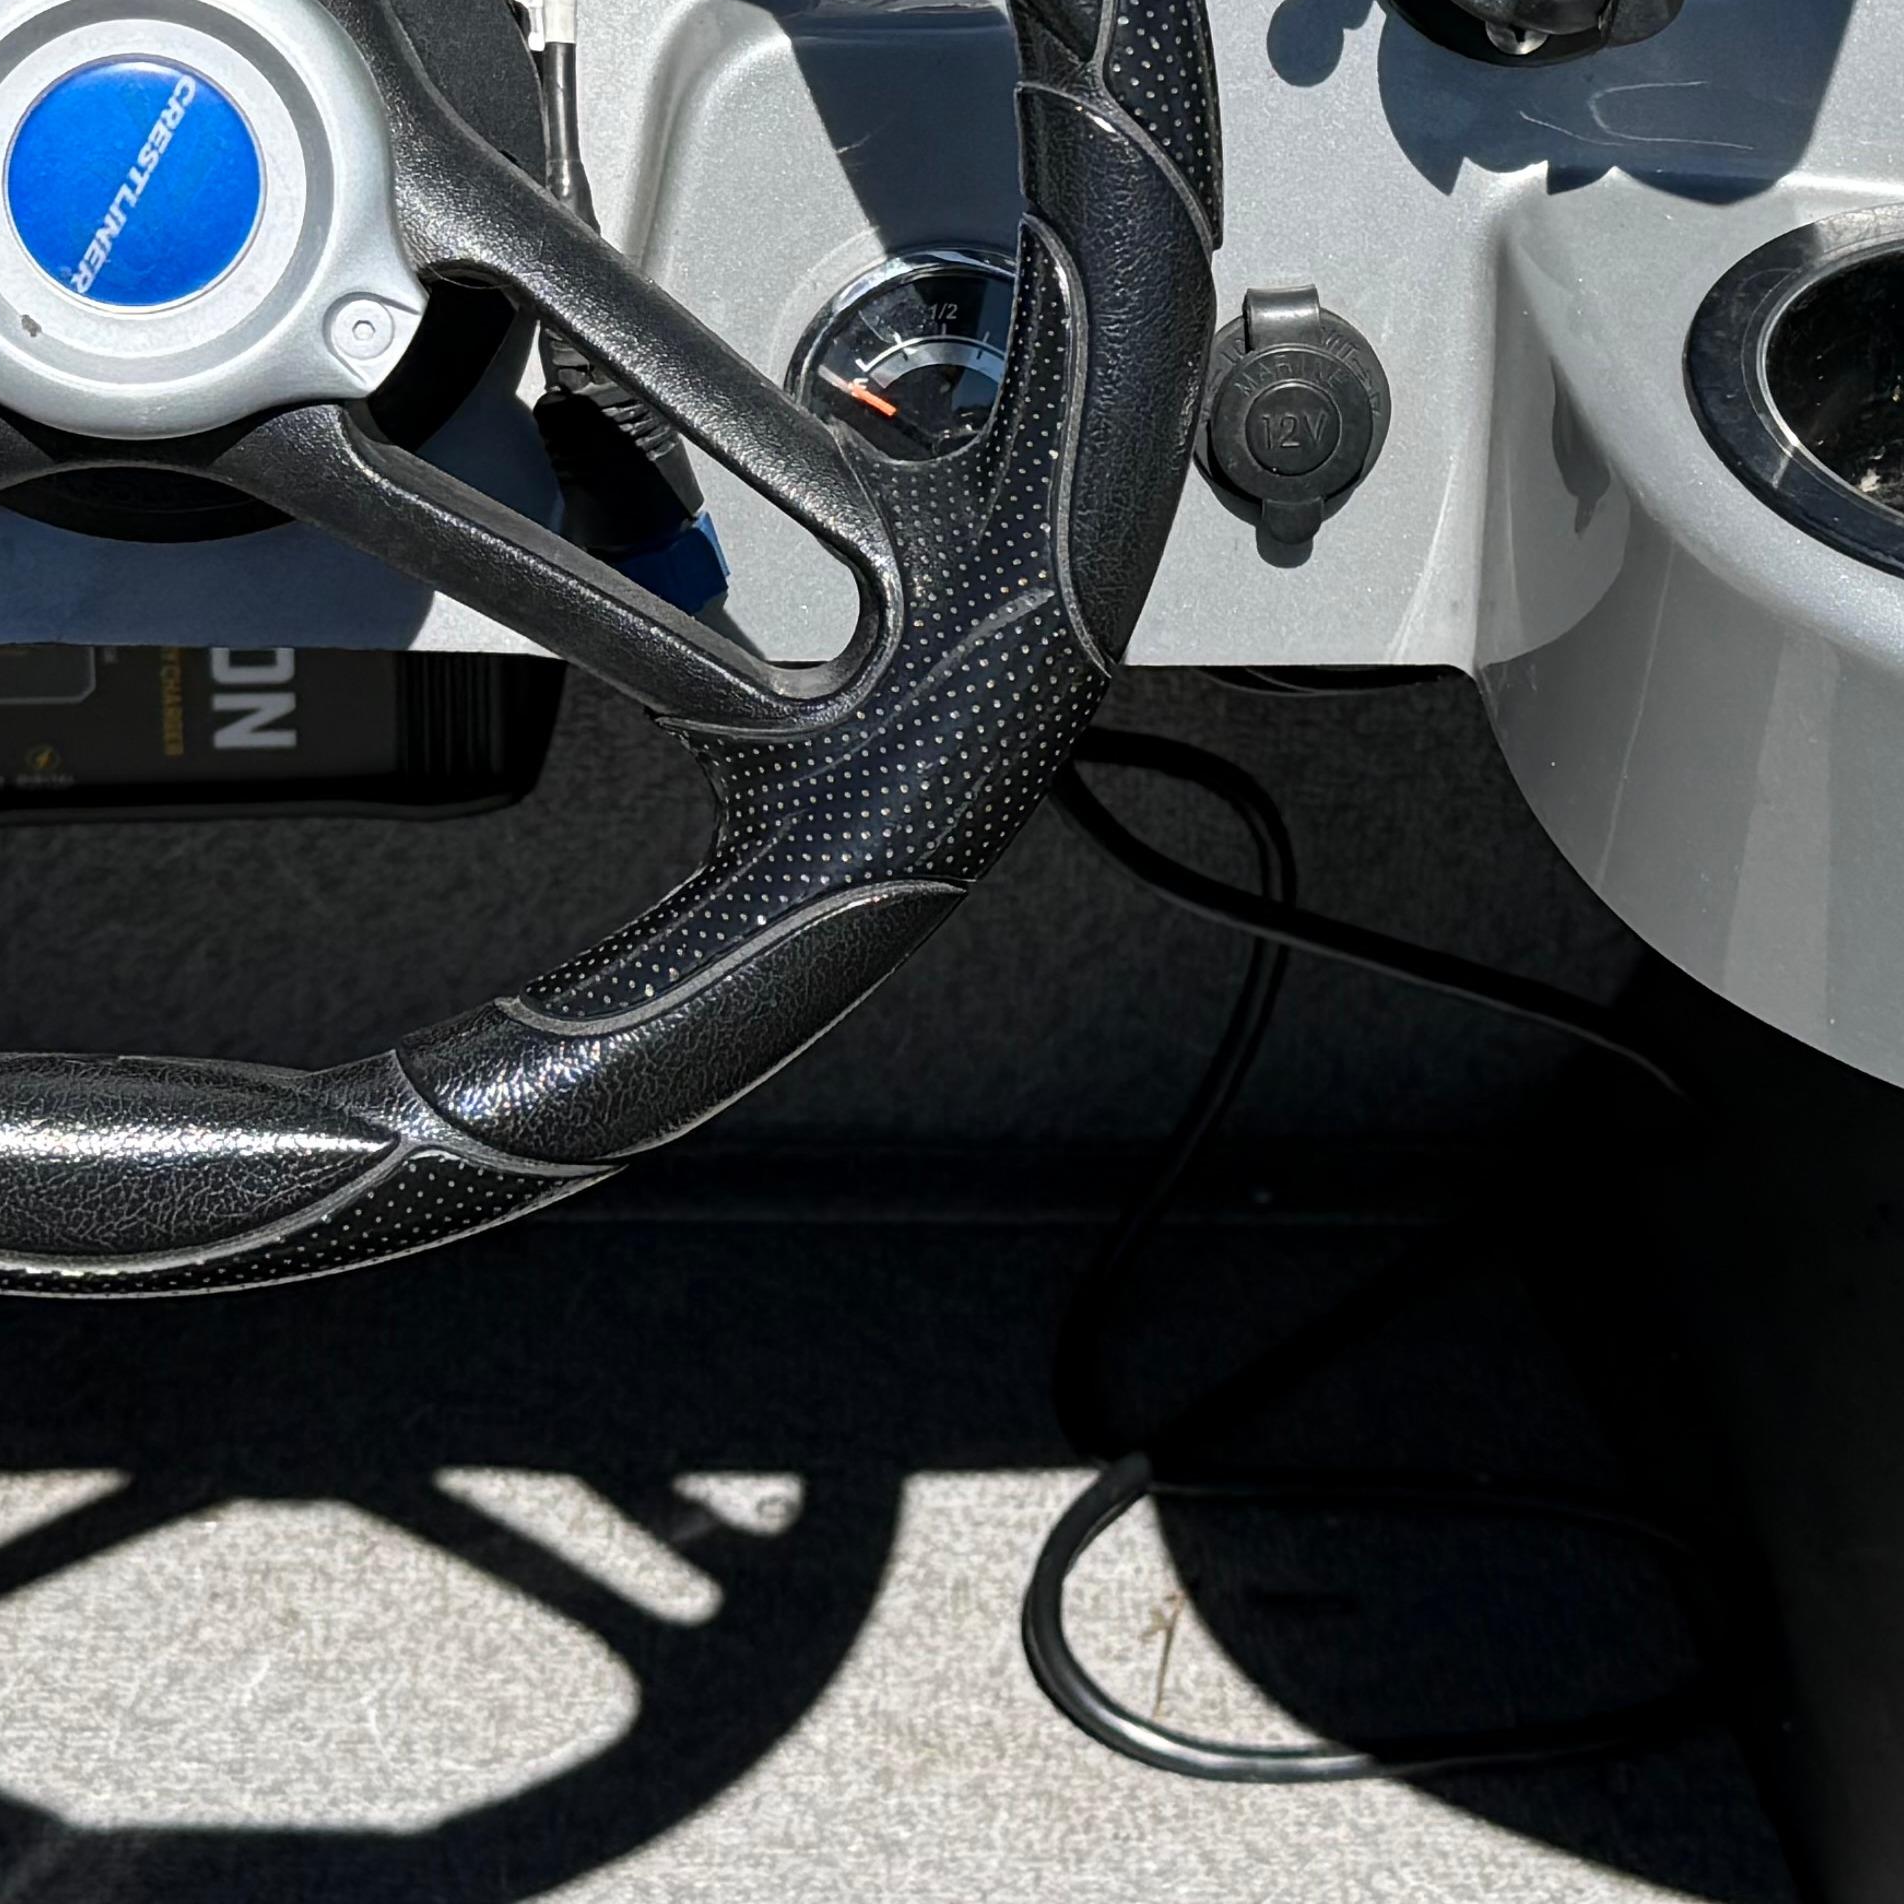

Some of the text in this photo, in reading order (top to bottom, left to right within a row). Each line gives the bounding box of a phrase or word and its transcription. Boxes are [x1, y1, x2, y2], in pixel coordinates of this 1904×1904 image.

[71, 74, 197, 294] CRESTLINER
[928, 303, 958, 321] 1/2
[1260, 407, 1330, 449] 12V
